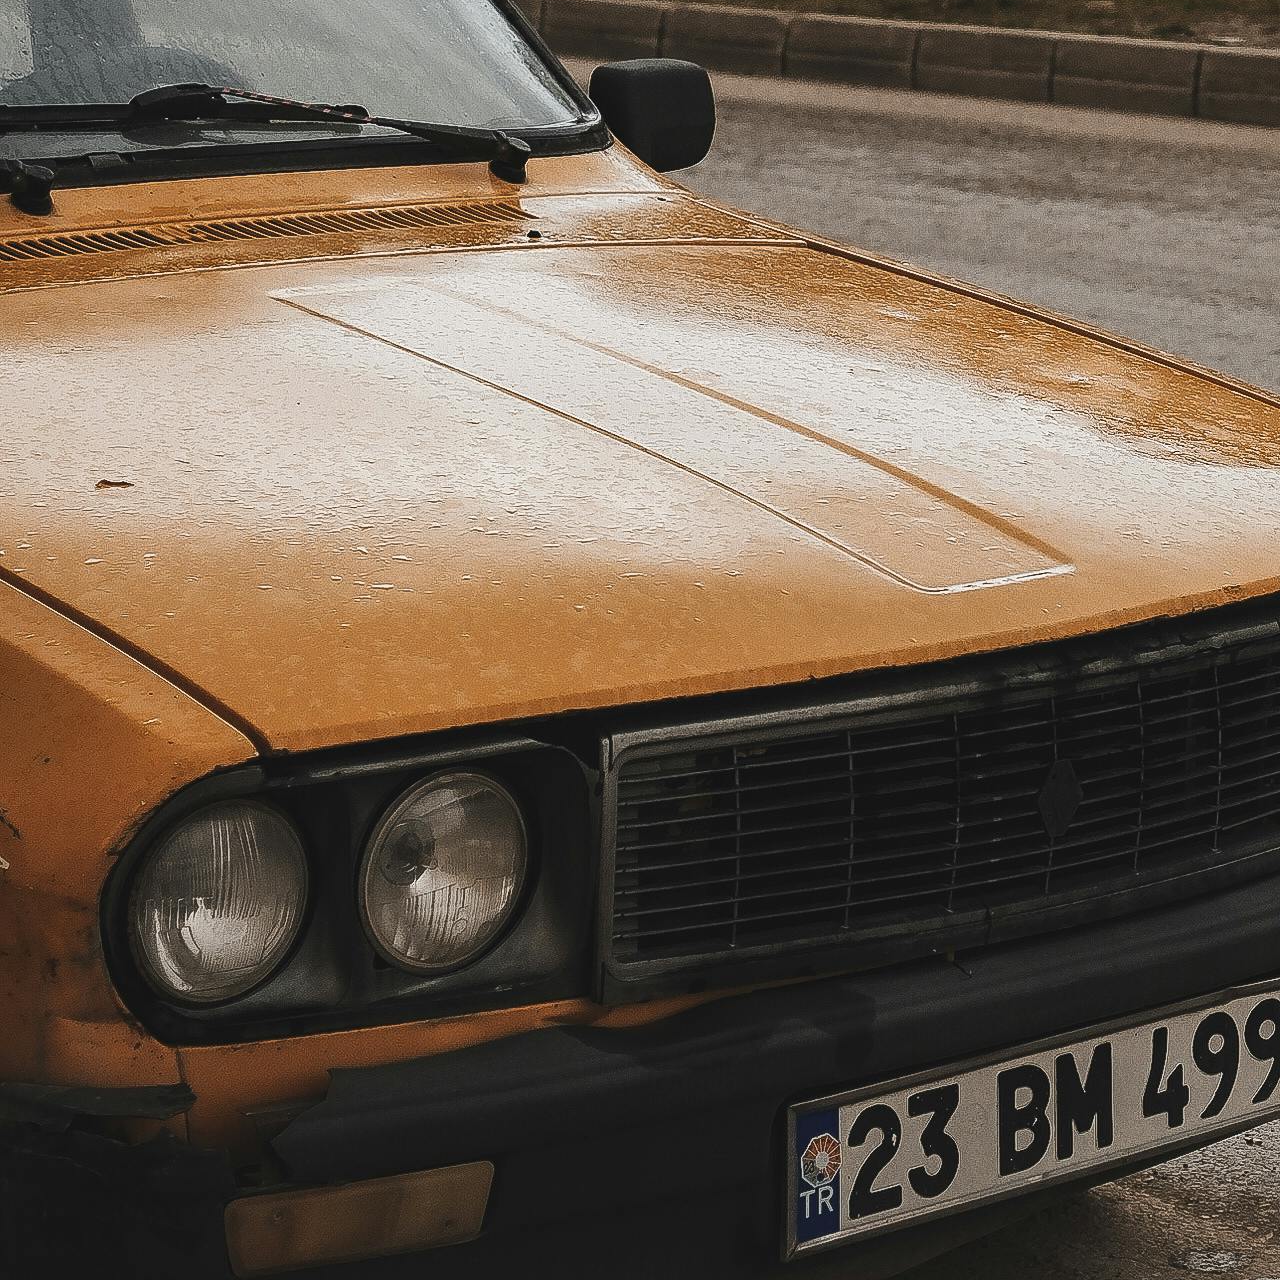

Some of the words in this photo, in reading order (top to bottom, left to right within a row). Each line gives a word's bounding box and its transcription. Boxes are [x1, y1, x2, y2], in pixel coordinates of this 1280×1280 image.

[847, 1084, 960, 1220] 23
[998, 1043, 1114, 1176] BM
[799, 1185, 834, 1219] TR
